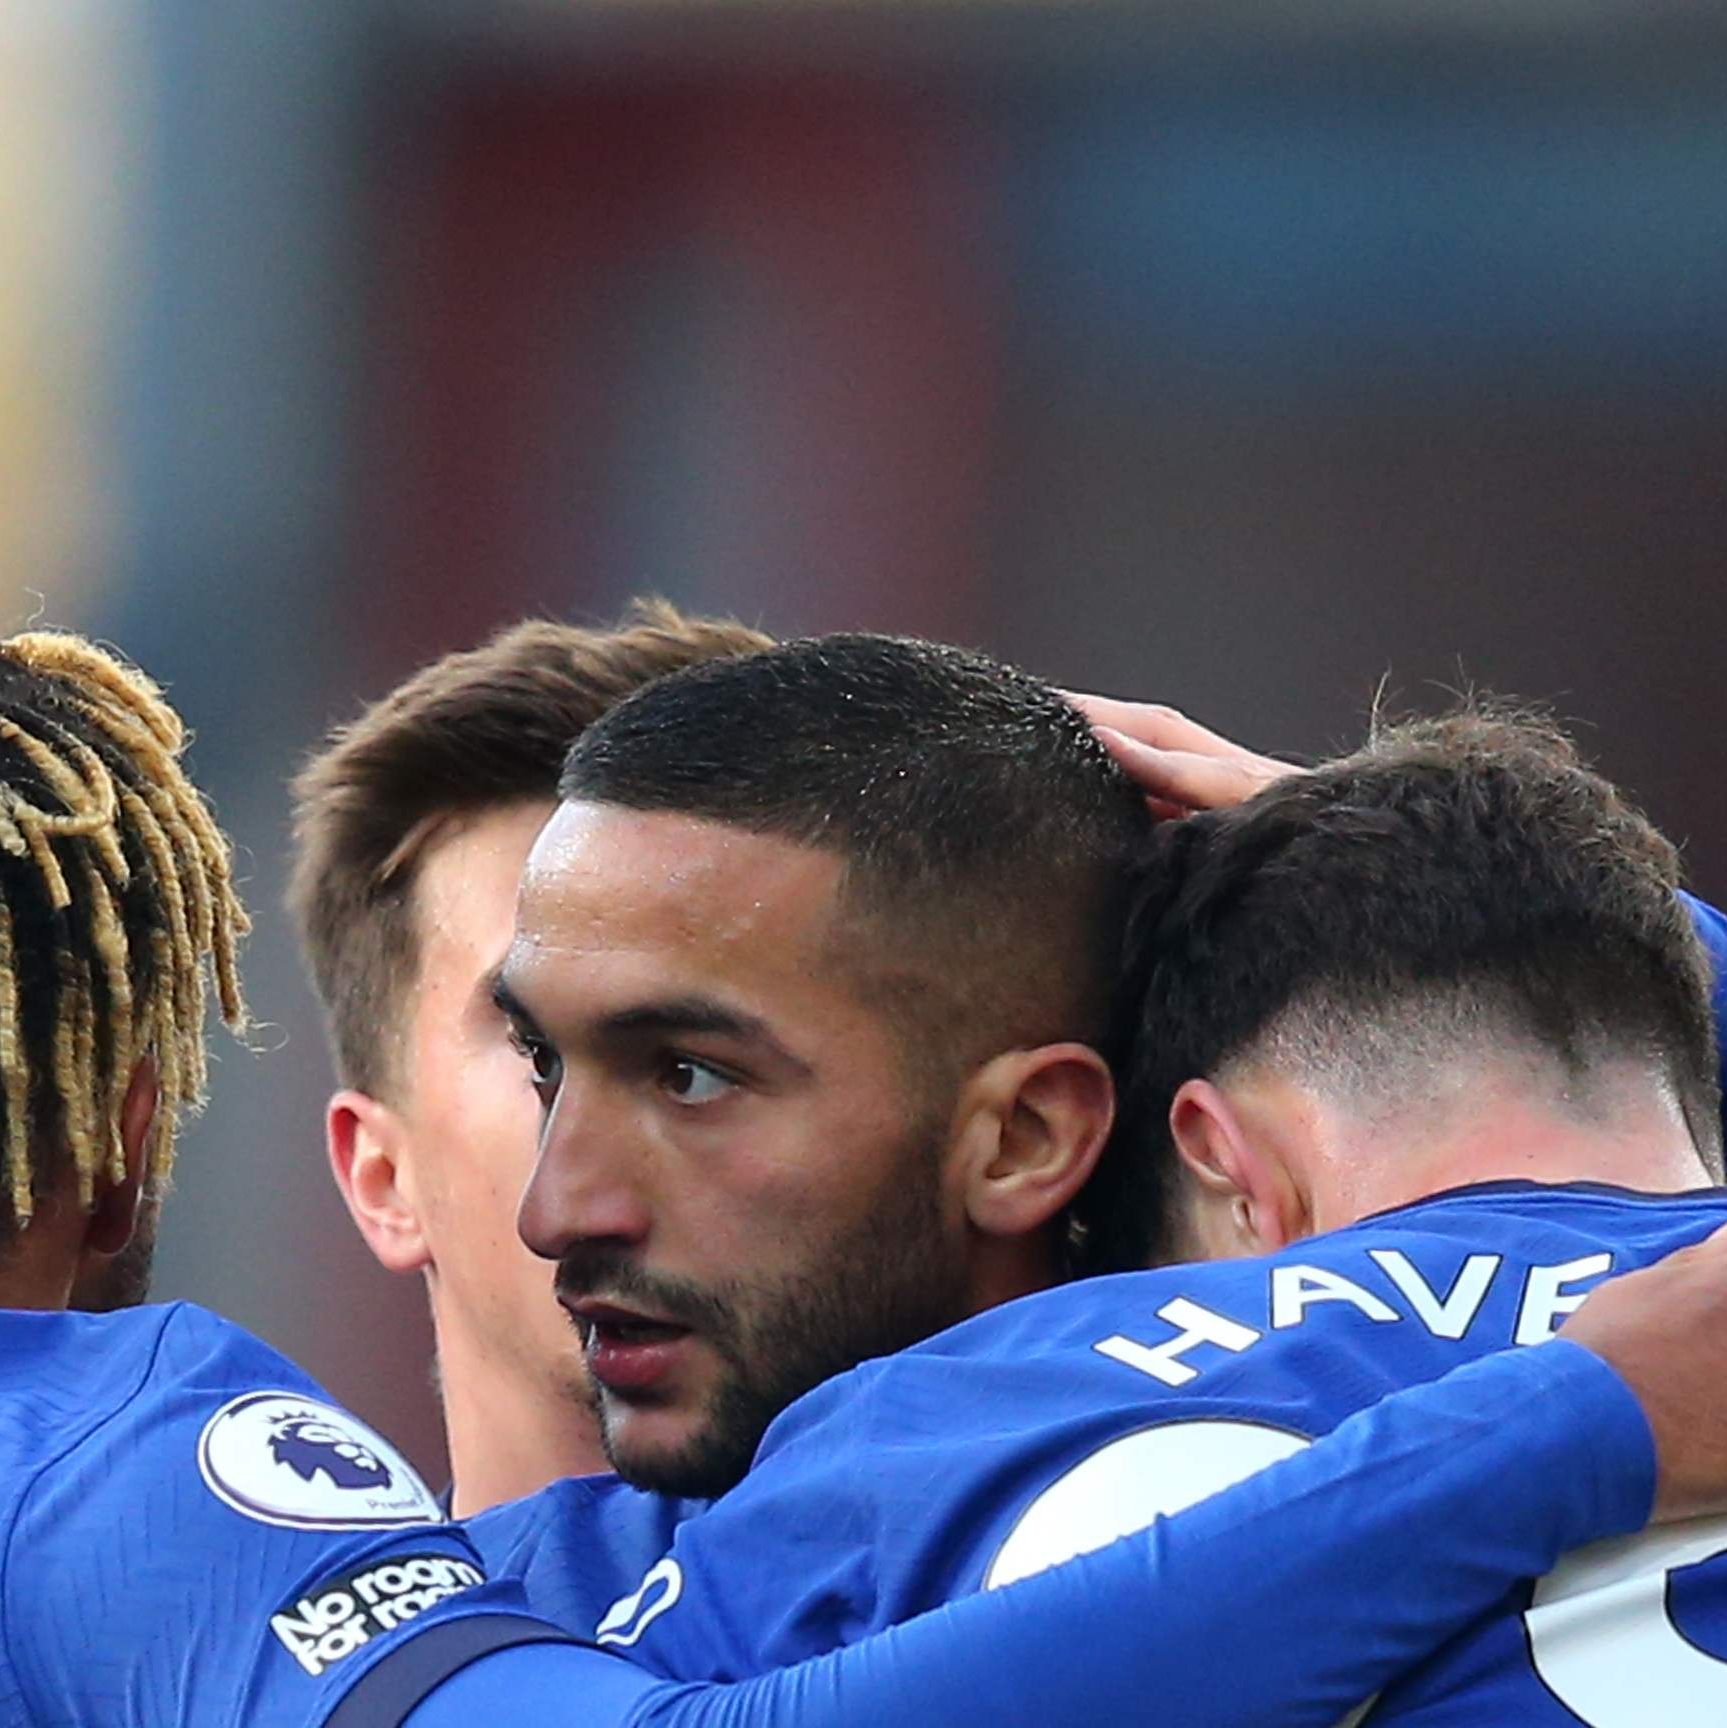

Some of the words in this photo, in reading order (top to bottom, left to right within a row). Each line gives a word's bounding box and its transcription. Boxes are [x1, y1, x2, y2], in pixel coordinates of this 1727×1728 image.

[1093, 1248, 1615, 1386] HAVE
[269, 1591, 356, 1657] No
[352, 1558, 485, 1605] room
[294, 1612, 371, 1677] for
